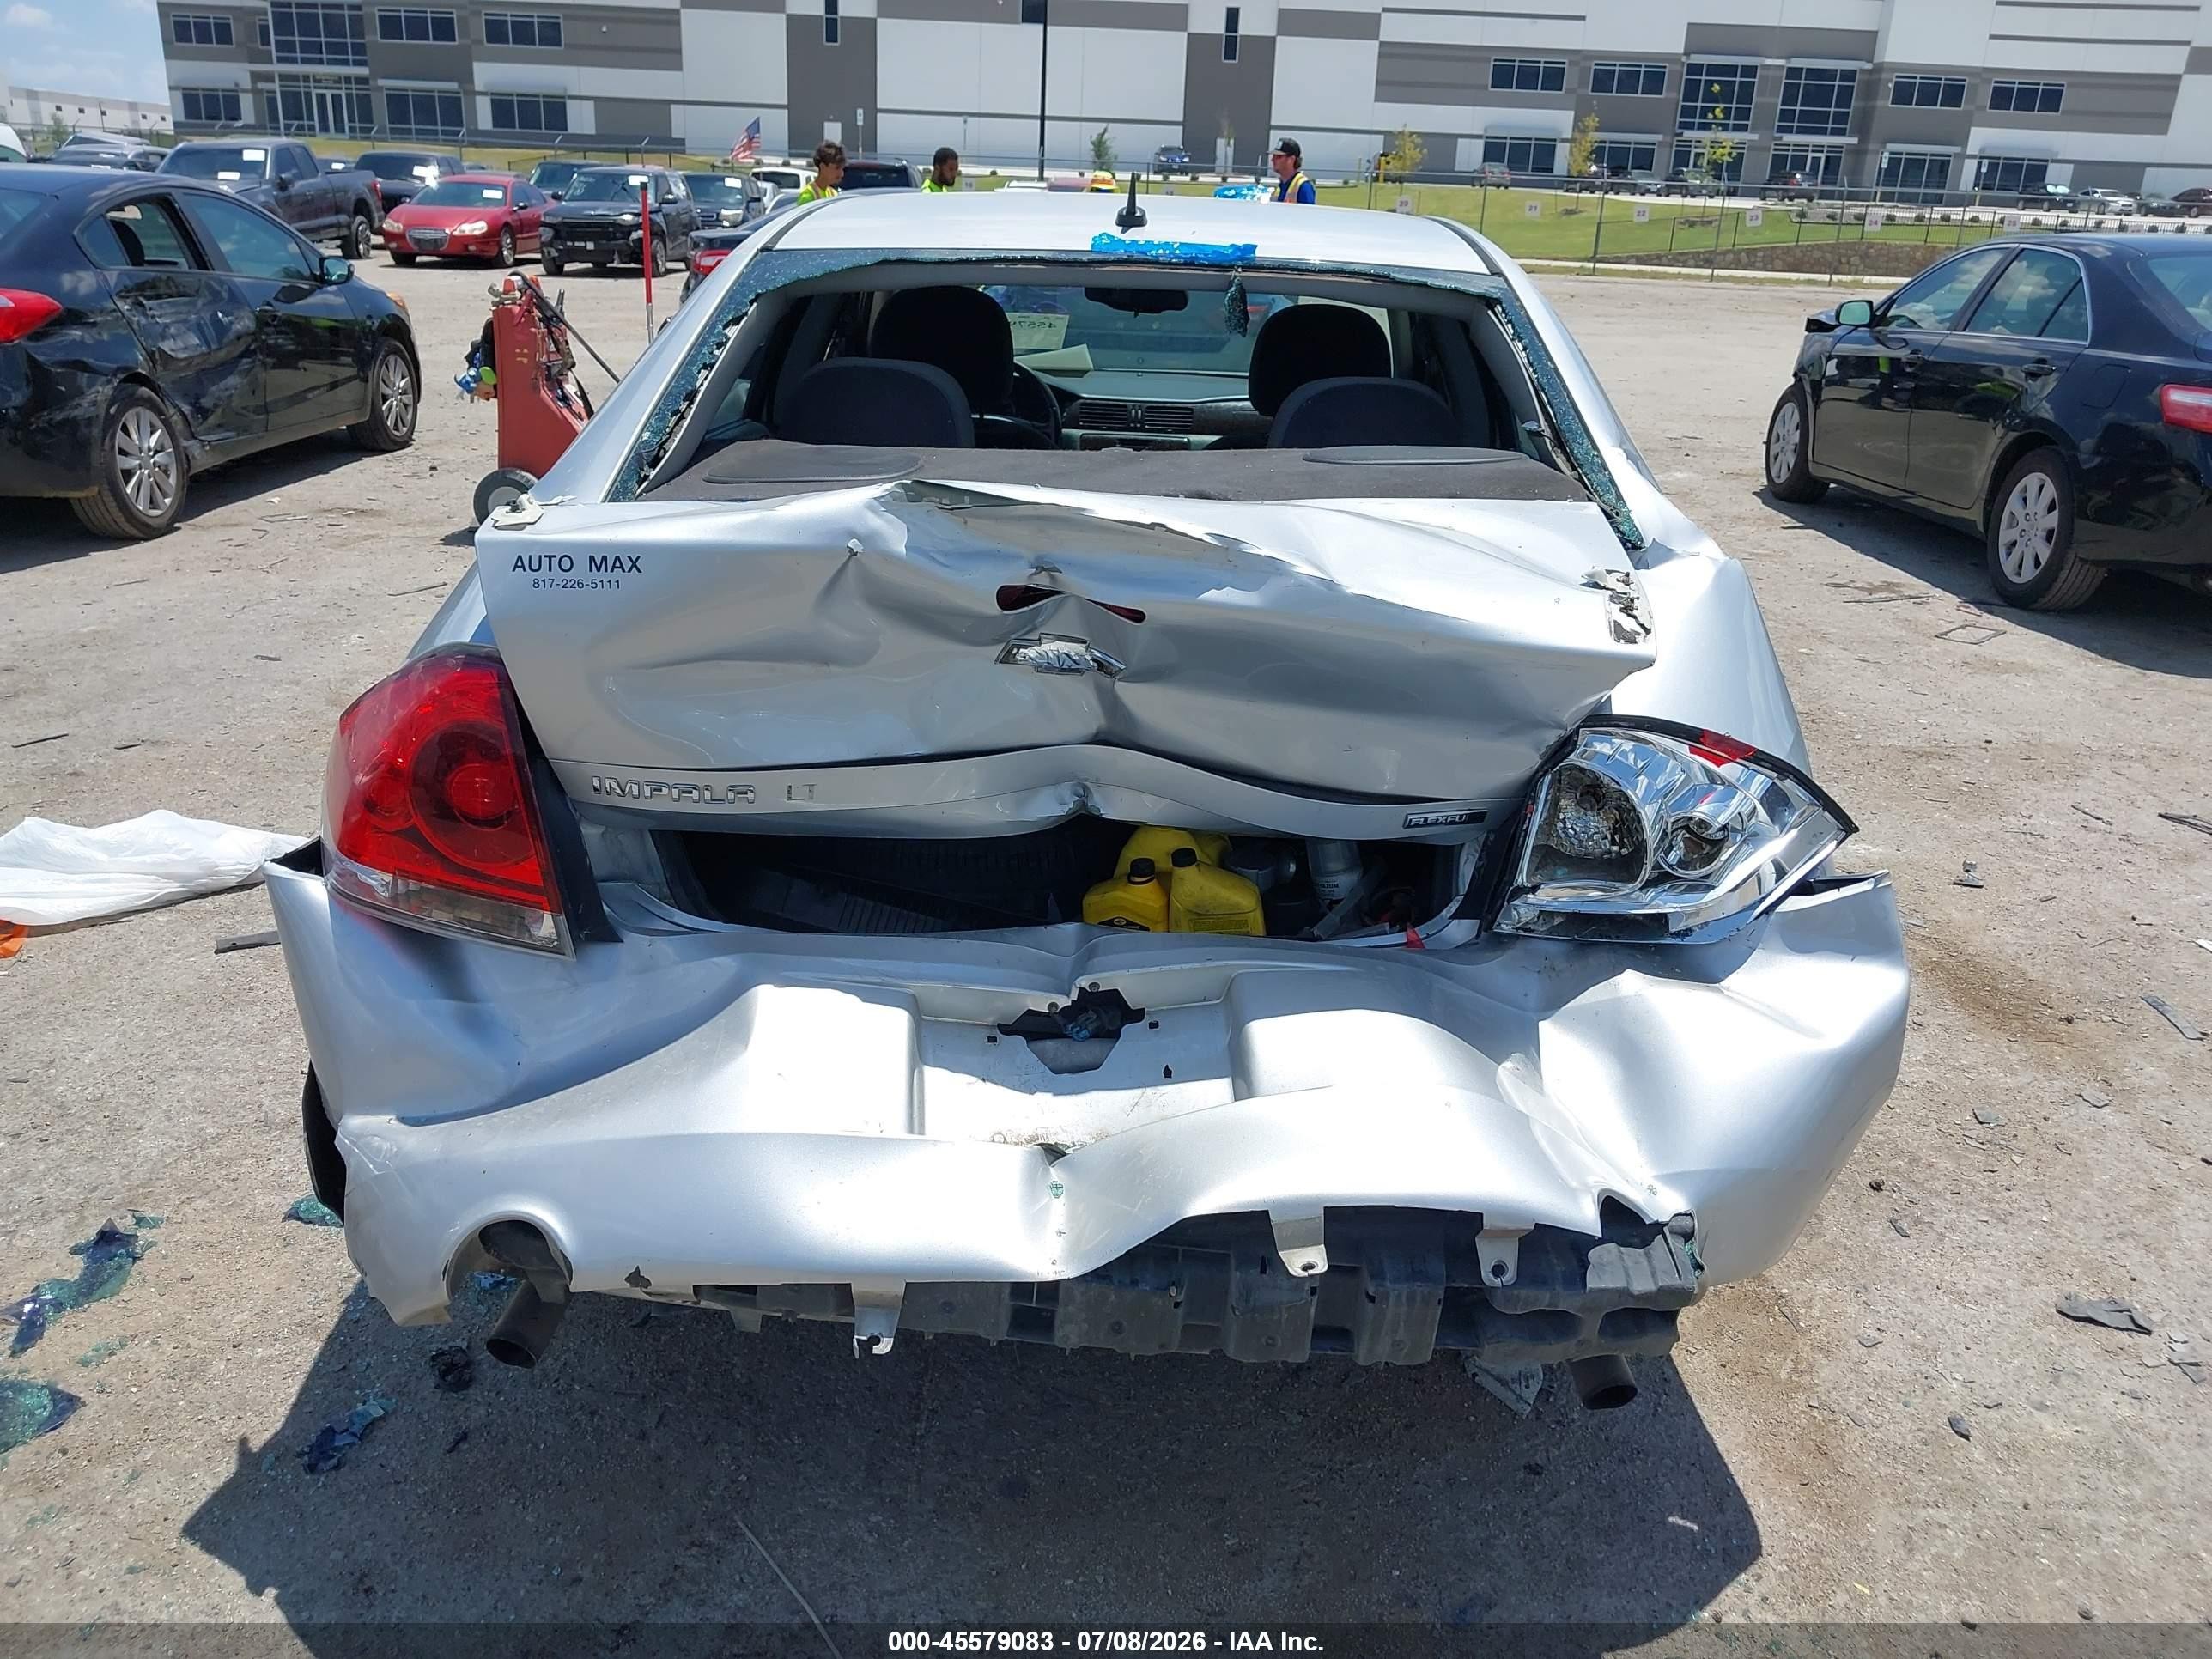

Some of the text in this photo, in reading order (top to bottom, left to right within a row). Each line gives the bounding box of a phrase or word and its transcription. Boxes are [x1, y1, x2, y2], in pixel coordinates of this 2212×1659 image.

[512, 555, 642, 574] AUTO MAX
[532, 578, 621, 590] 817-226-5111
[592, 775, 817, 805] IMPALA LT
